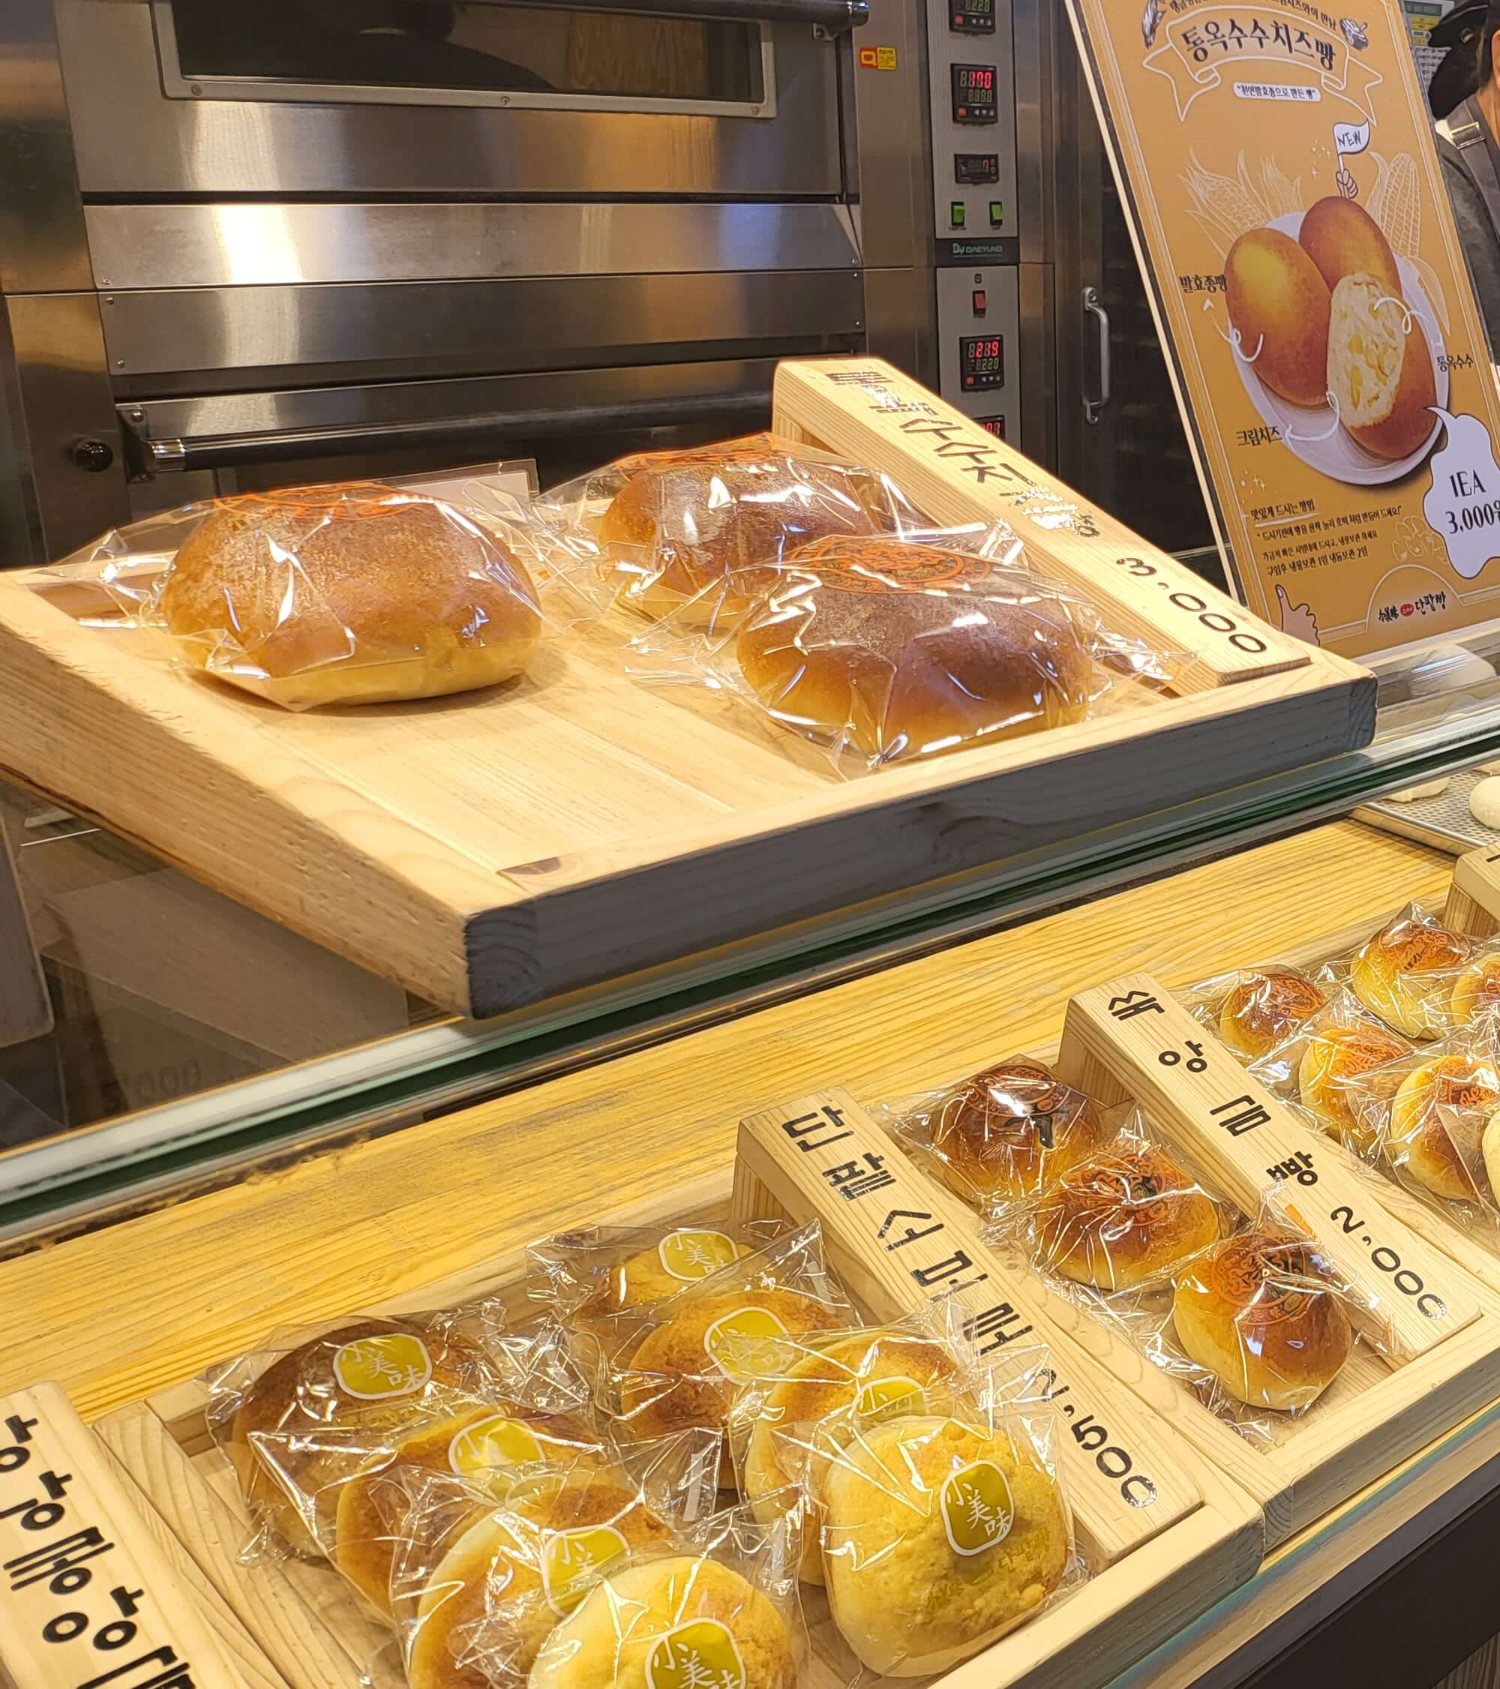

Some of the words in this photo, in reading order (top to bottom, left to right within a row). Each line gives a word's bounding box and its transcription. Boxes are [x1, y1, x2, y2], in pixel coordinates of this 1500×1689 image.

[1181, 18, 1337, 71] 통옥수수치즈빵
[1336, 129, 1363, 149] NEW
[1179, 273, 1228, 295] 발효종빵
[1436, 353, 1475, 373] 통옥수수
[1236, 426, 1281, 448] 크림치즈
[1250, 506, 1274, 522] 맛있게
[1275, 503, 1299, 516] 드시는
[1299, 498, 1316, 512] 방법
[1267, 563, 1289, 577] 구입후
[1288, 556, 1317, 573] 냉장보관
[1115, 556, 1267, 654] 3,000
[1415, 591, 1446, 616] 단팥빵
[1330, 1205, 1448, 1320] 2,000
[782, 1104, 1035, 1358] 단팥소보로
[1031, 1368, 1158, 1509] 2,500
[341, 1341, 422, 1397] 小美味
[945, 1476, 1013, 1540] 小美味
